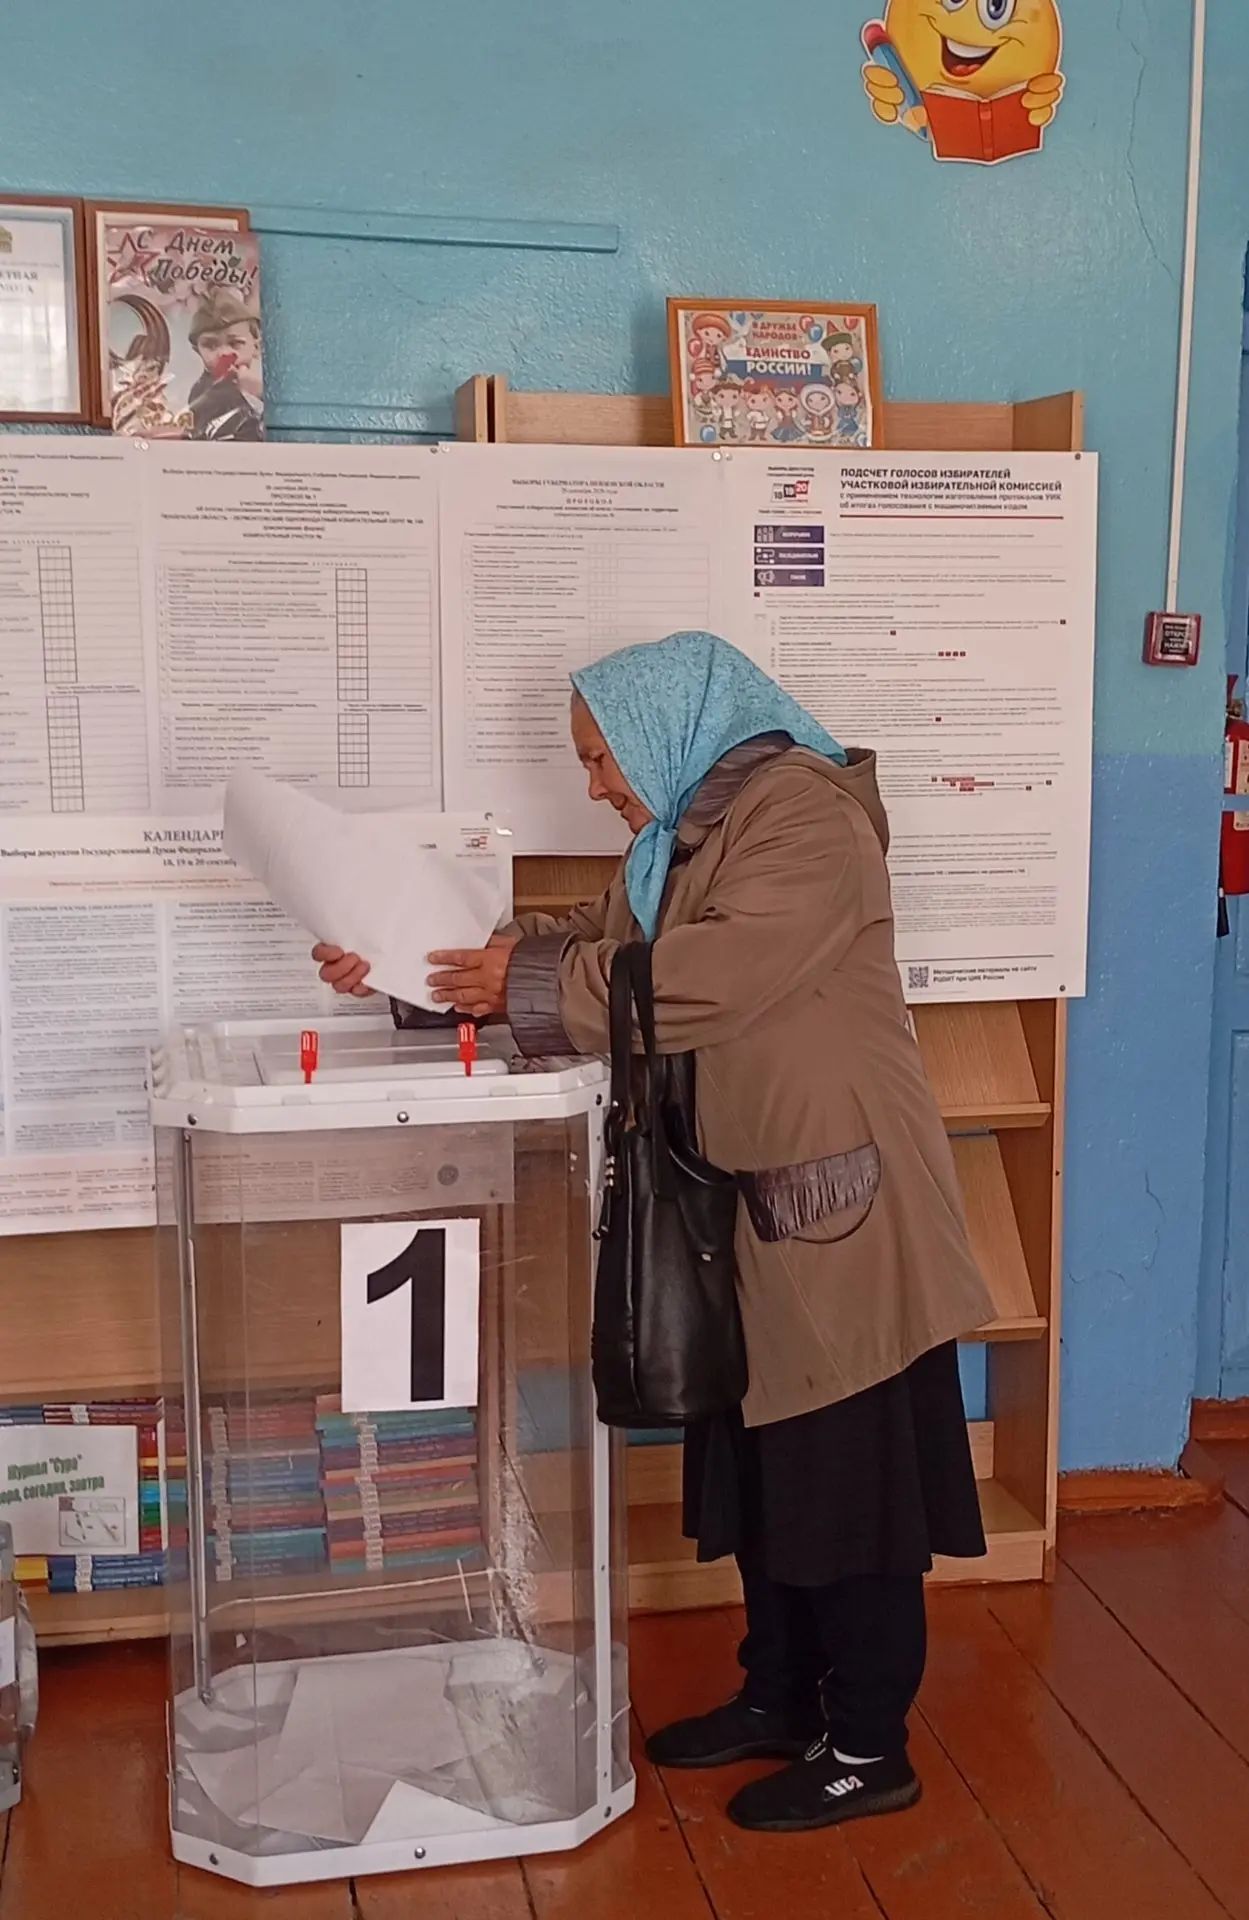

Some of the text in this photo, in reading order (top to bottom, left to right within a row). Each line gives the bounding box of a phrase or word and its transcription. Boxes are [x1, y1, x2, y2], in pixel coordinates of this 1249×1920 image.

[136, 231, 234, 254] С Днем
[152, 258, 258, 286] Победы!
[746, 347, 811, 359] ЕДИНСТВО
[746, 361, 812, 375] РОССИИ!
[841, 468, 1011, 479] ПОДСЧЕТ ГОЛОСОВ ИЗБИРАТЕЛЕЙ
[841, 479, 1062, 491] УЧАСТКОВОЙ ИЗБИРАТЕЛЬНОЙ КОМИССИЕЙ
[367, 1228, 446, 1402] 1
[69, 1475, 105, 1492] завтра
